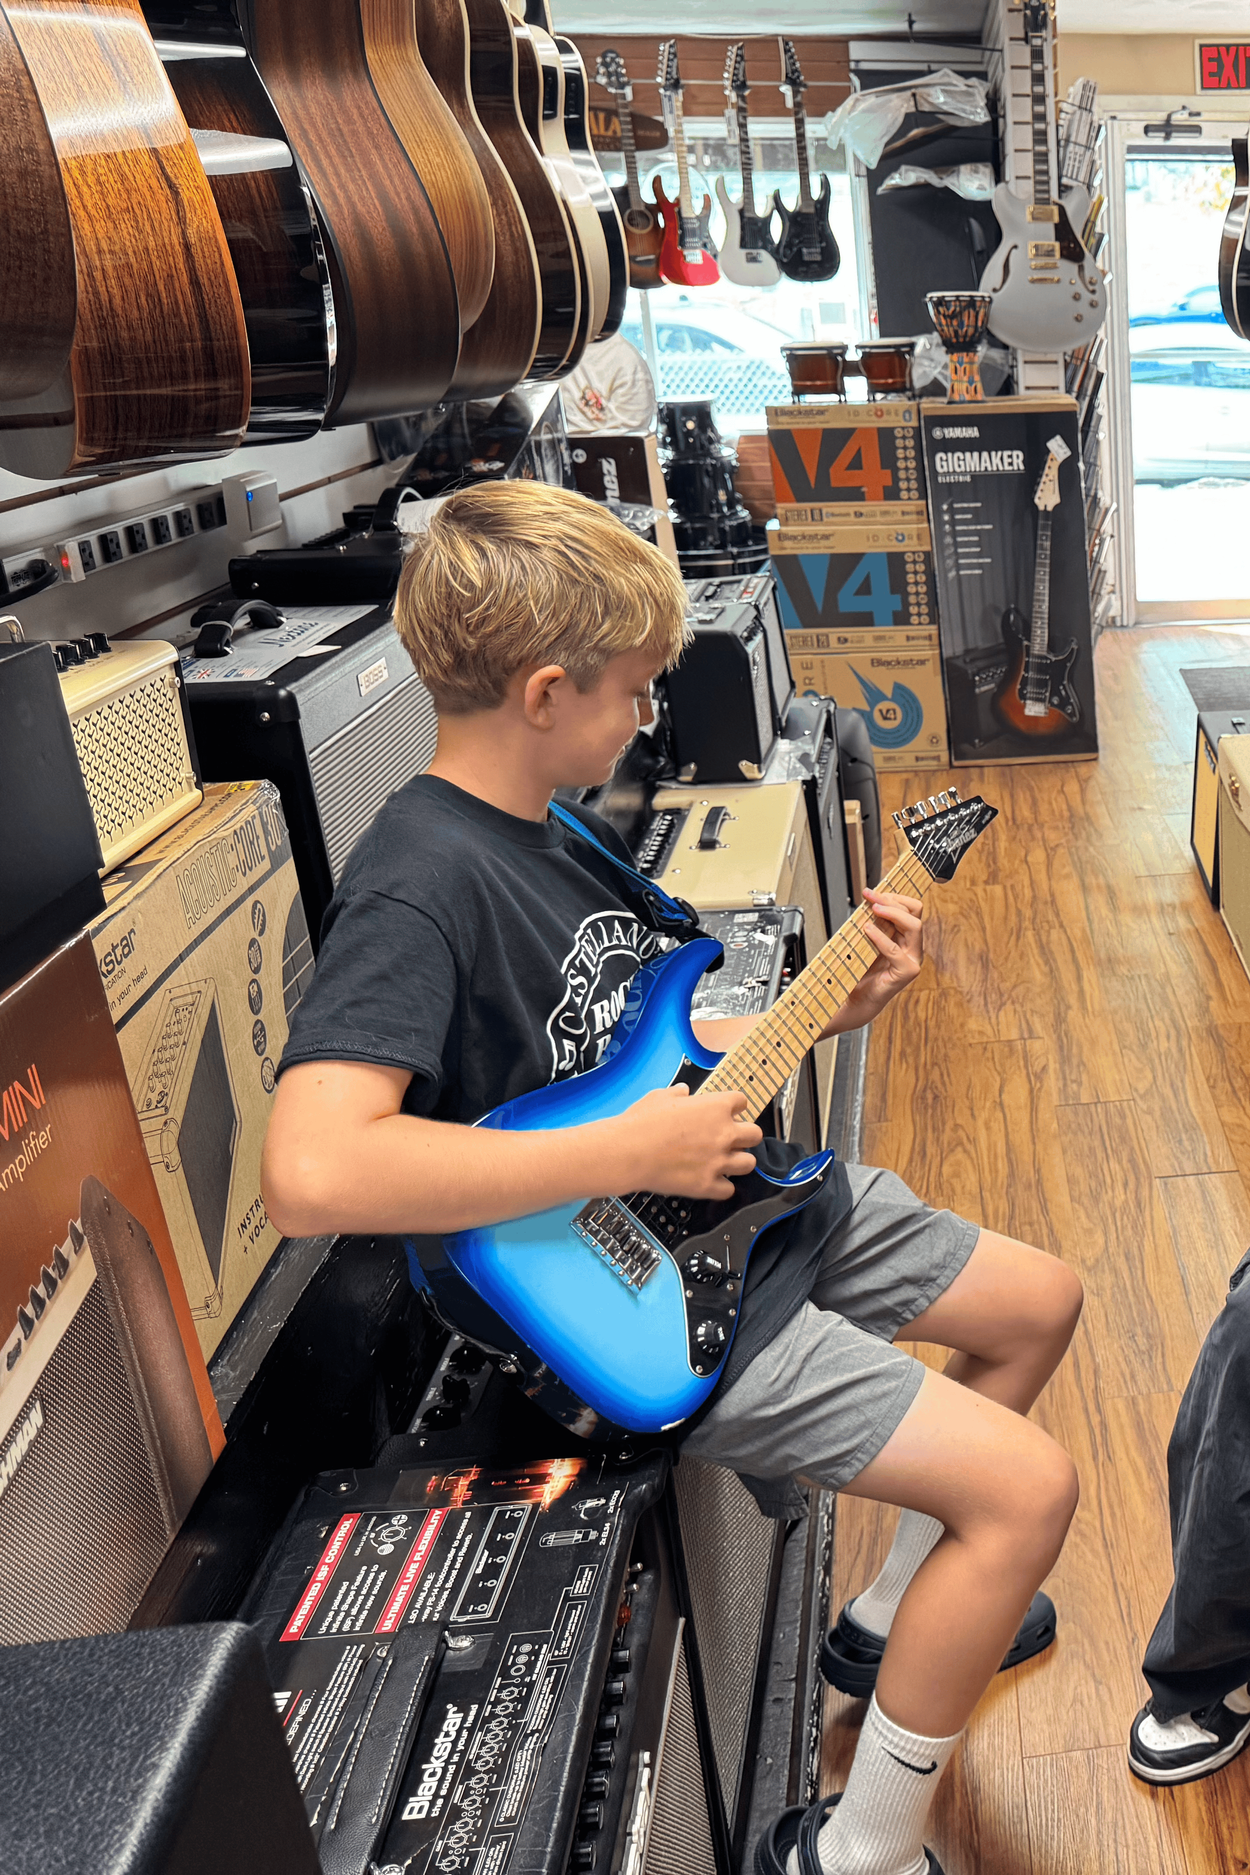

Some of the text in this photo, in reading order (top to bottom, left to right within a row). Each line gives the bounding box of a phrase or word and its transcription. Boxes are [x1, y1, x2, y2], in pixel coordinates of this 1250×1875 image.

[943, 427, 980, 438] YAMAHA
[935, 450, 1025, 473] GIGMAKER
[938, 475, 971, 483] ELECTRIC
[871, 658, 930, 668] Blackstar
[364, 664, 384, 688] BOSS
[117, 984, 132, 1005] your
[132, 964, 148, 987] head
[454, 1519, 469, 1538] access
[457, 1532, 475, 1555] Reverb.
[380, 1510, 444, 1629] ULTIMATE LIVE FLEXIBILITY
[453, 1556, 464, 1568] and
[288, 1518, 353, 1632] PATENTED ISF CONTROL
[445, 1569, 460, 1587] Boost
[330, 1565, 368, 1632] Infinite Shape Feature
[349, 1595, 365, 1615] allows
[359, 1572, 375, 1593] access
[352, 1569, 388, 1630] Infinite new sounds.
[317, 1581, 350, 1633] Unique patented
[406, 1609, 420, 1623] LSO
[462, 1704, 480, 1726] head
[453, 1729, 472, 1750] your
[402, 1706, 463, 1820] Blackstar
[449, 1753, 461, 1762] in
[437, 1764, 459, 1795] sound
[429, 1798, 445, 1816] the
